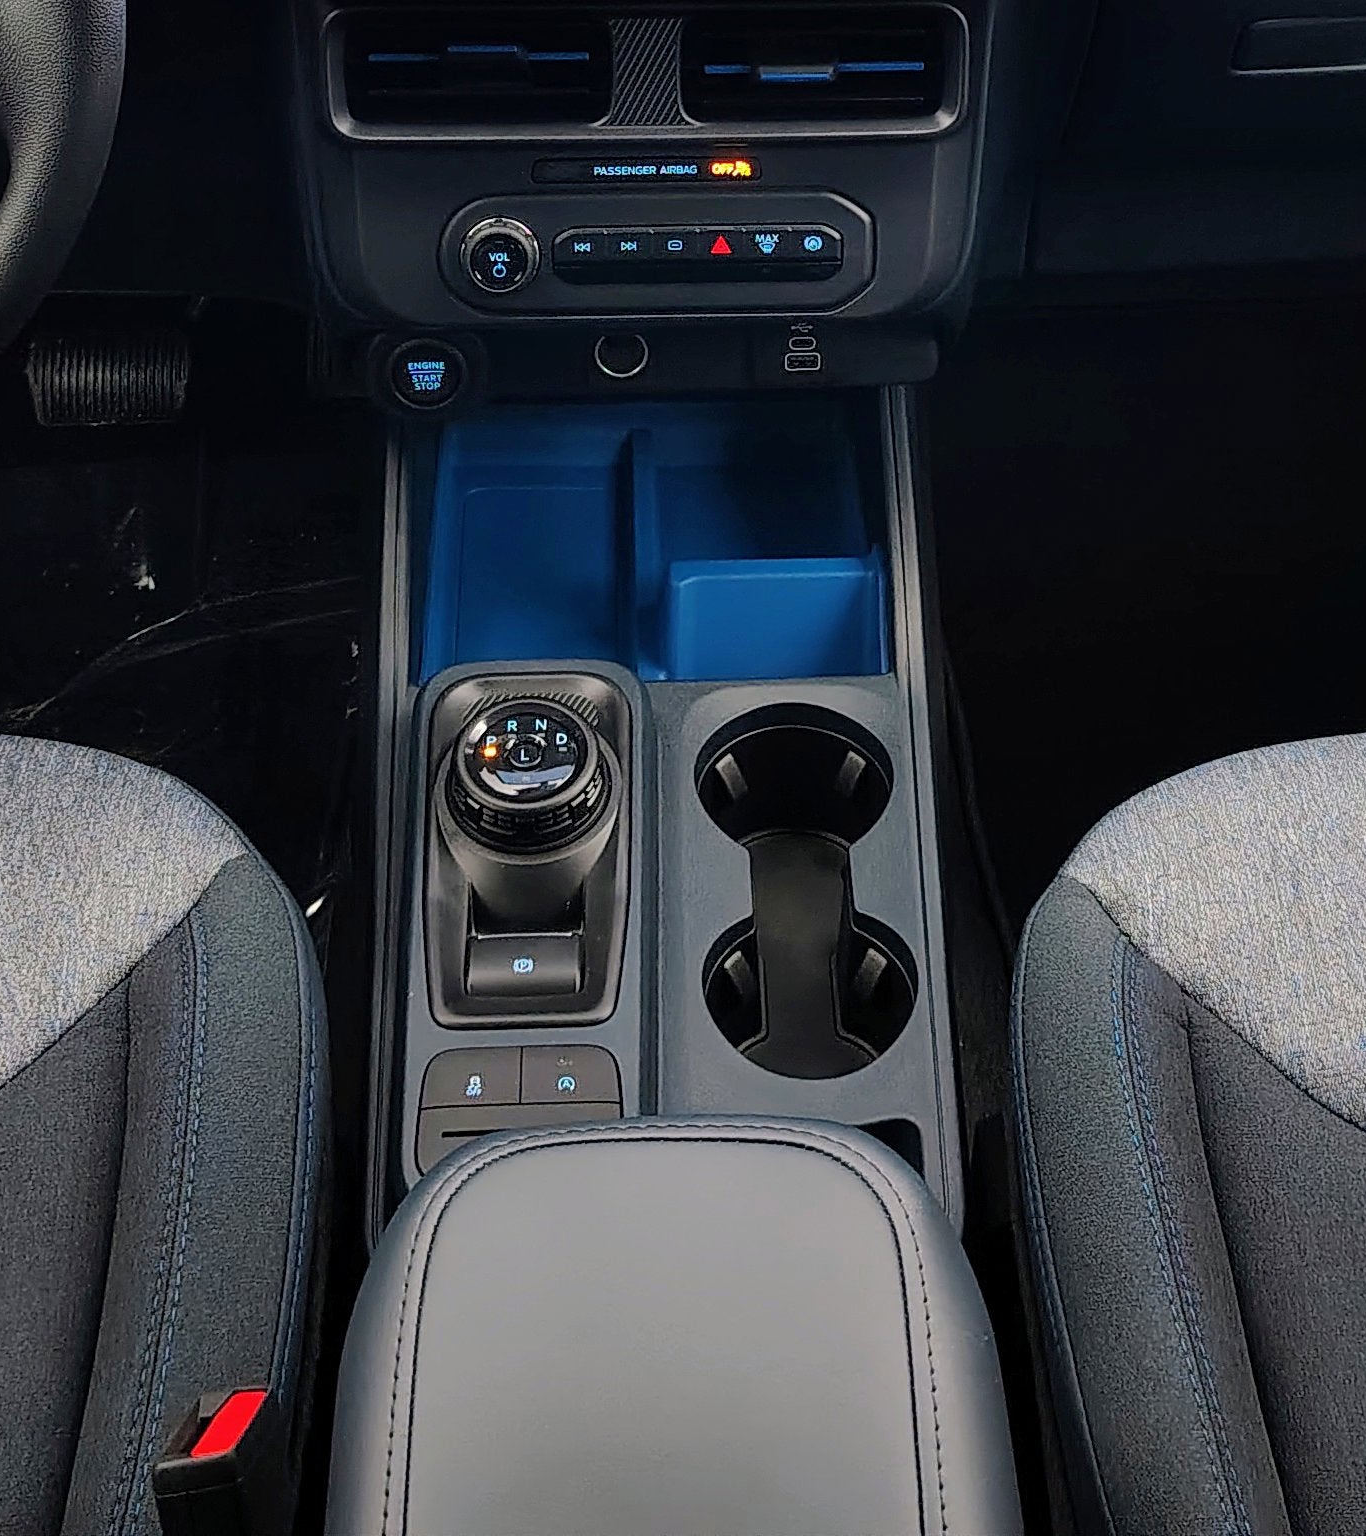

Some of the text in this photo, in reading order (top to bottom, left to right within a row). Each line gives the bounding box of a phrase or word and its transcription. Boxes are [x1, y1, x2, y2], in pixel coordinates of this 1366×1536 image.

[593, 165, 698, 176] PASSENGER AIRBAG
[755, 234, 779, 243] MAX
[489, 253, 510, 262] VOL
[407, 362, 446, 370] ENGINE
[411, 375, 443, 383] START
[414, 382, 441, 391] STOP
[507, 720, 518, 732] R
[535, 719, 547, 731] N
[486, 735, 497, 747] P
[556, 733, 568, 745] D
[520, 748, 530, 761] L
